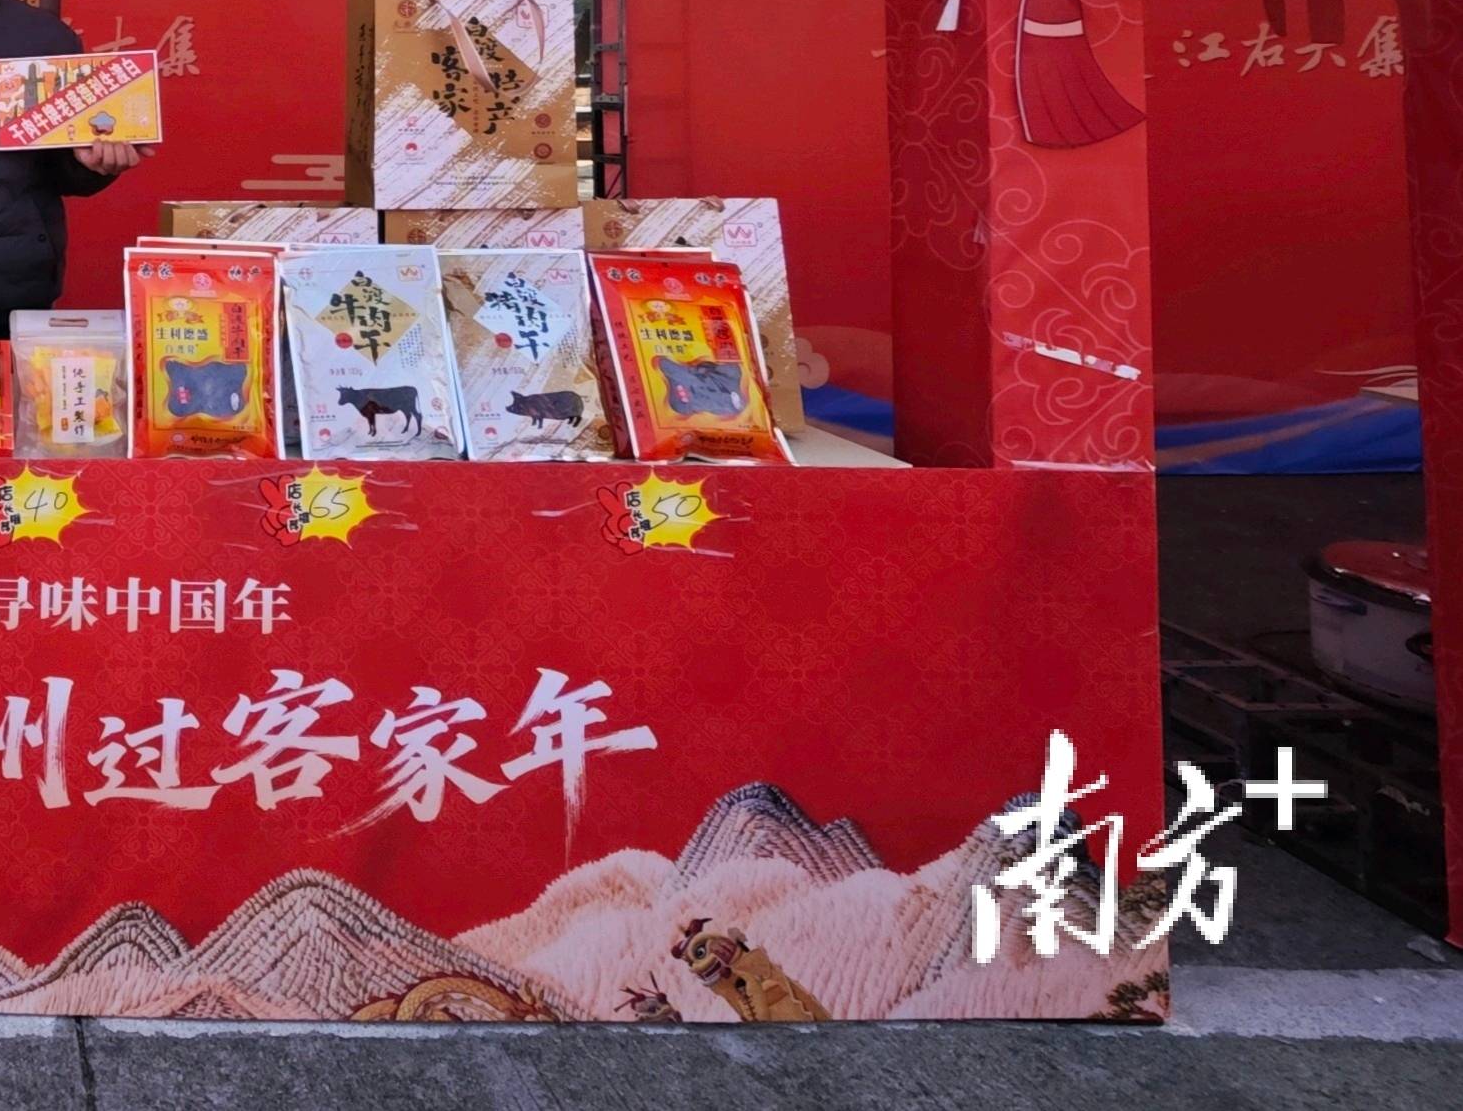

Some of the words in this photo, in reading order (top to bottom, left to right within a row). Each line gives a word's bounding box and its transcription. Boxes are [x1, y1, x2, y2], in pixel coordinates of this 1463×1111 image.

[24, 488, 69, 522] 40
[308, 486, 358, 520] 65
[650, 492, 702, 530] 50
